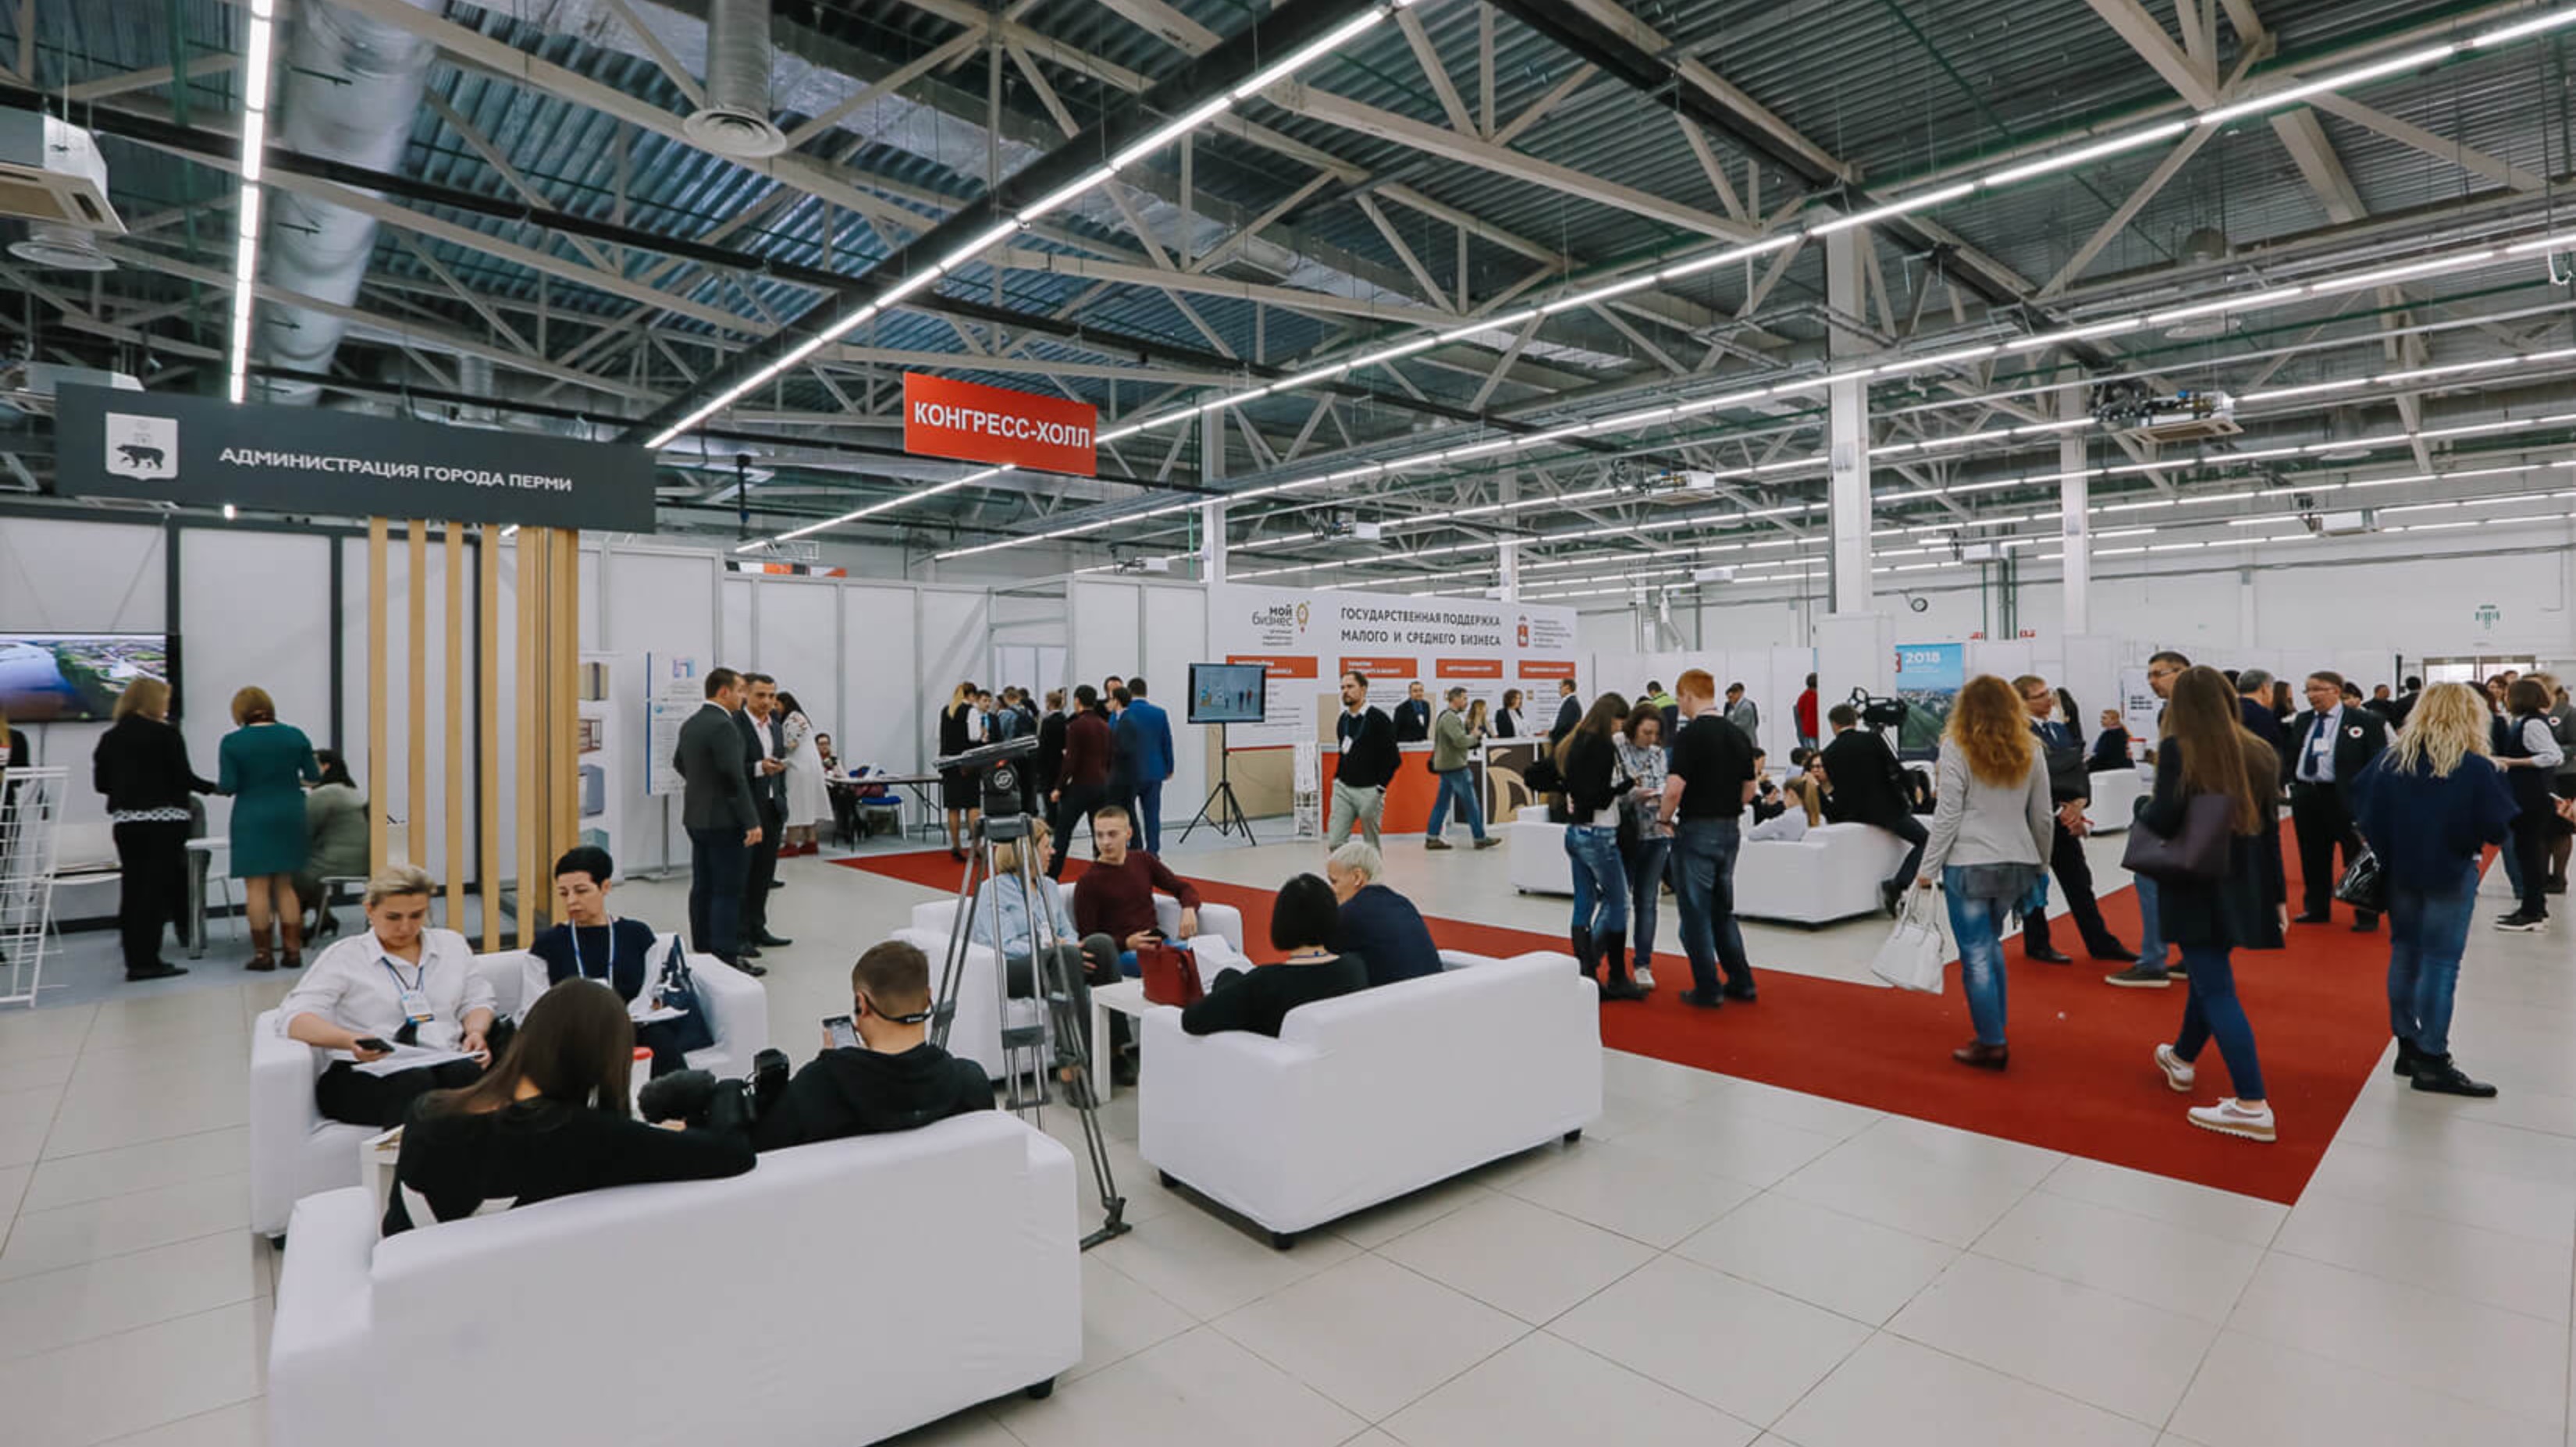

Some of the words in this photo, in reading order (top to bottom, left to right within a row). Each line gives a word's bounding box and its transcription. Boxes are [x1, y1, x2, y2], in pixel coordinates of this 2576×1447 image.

[914, 401, 1090, 449] КОНГРЕСС-ХОЛЛ
[219, 447, 419, 479] АДМИНИСТРАЦИЯ
[424, 466, 506, 487] ГОРОДА
[509, 474, 572, 492] ПЕРМИ
[1341, 607, 1441, 624] ГОСУДАРСТВЕННАЯ
[1443, 613, 1500, 626] ПОДДЕРЖКА
[1341, 630, 1389, 642] МАЛОГО
[1393, 631, 1401, 642] И
[1407, 632, 1456, 645] СРЕДНЕГО
[1461, 635, 1501, 646] БИЗНЕСА
[1905, 652, 1941, 663] 2018
